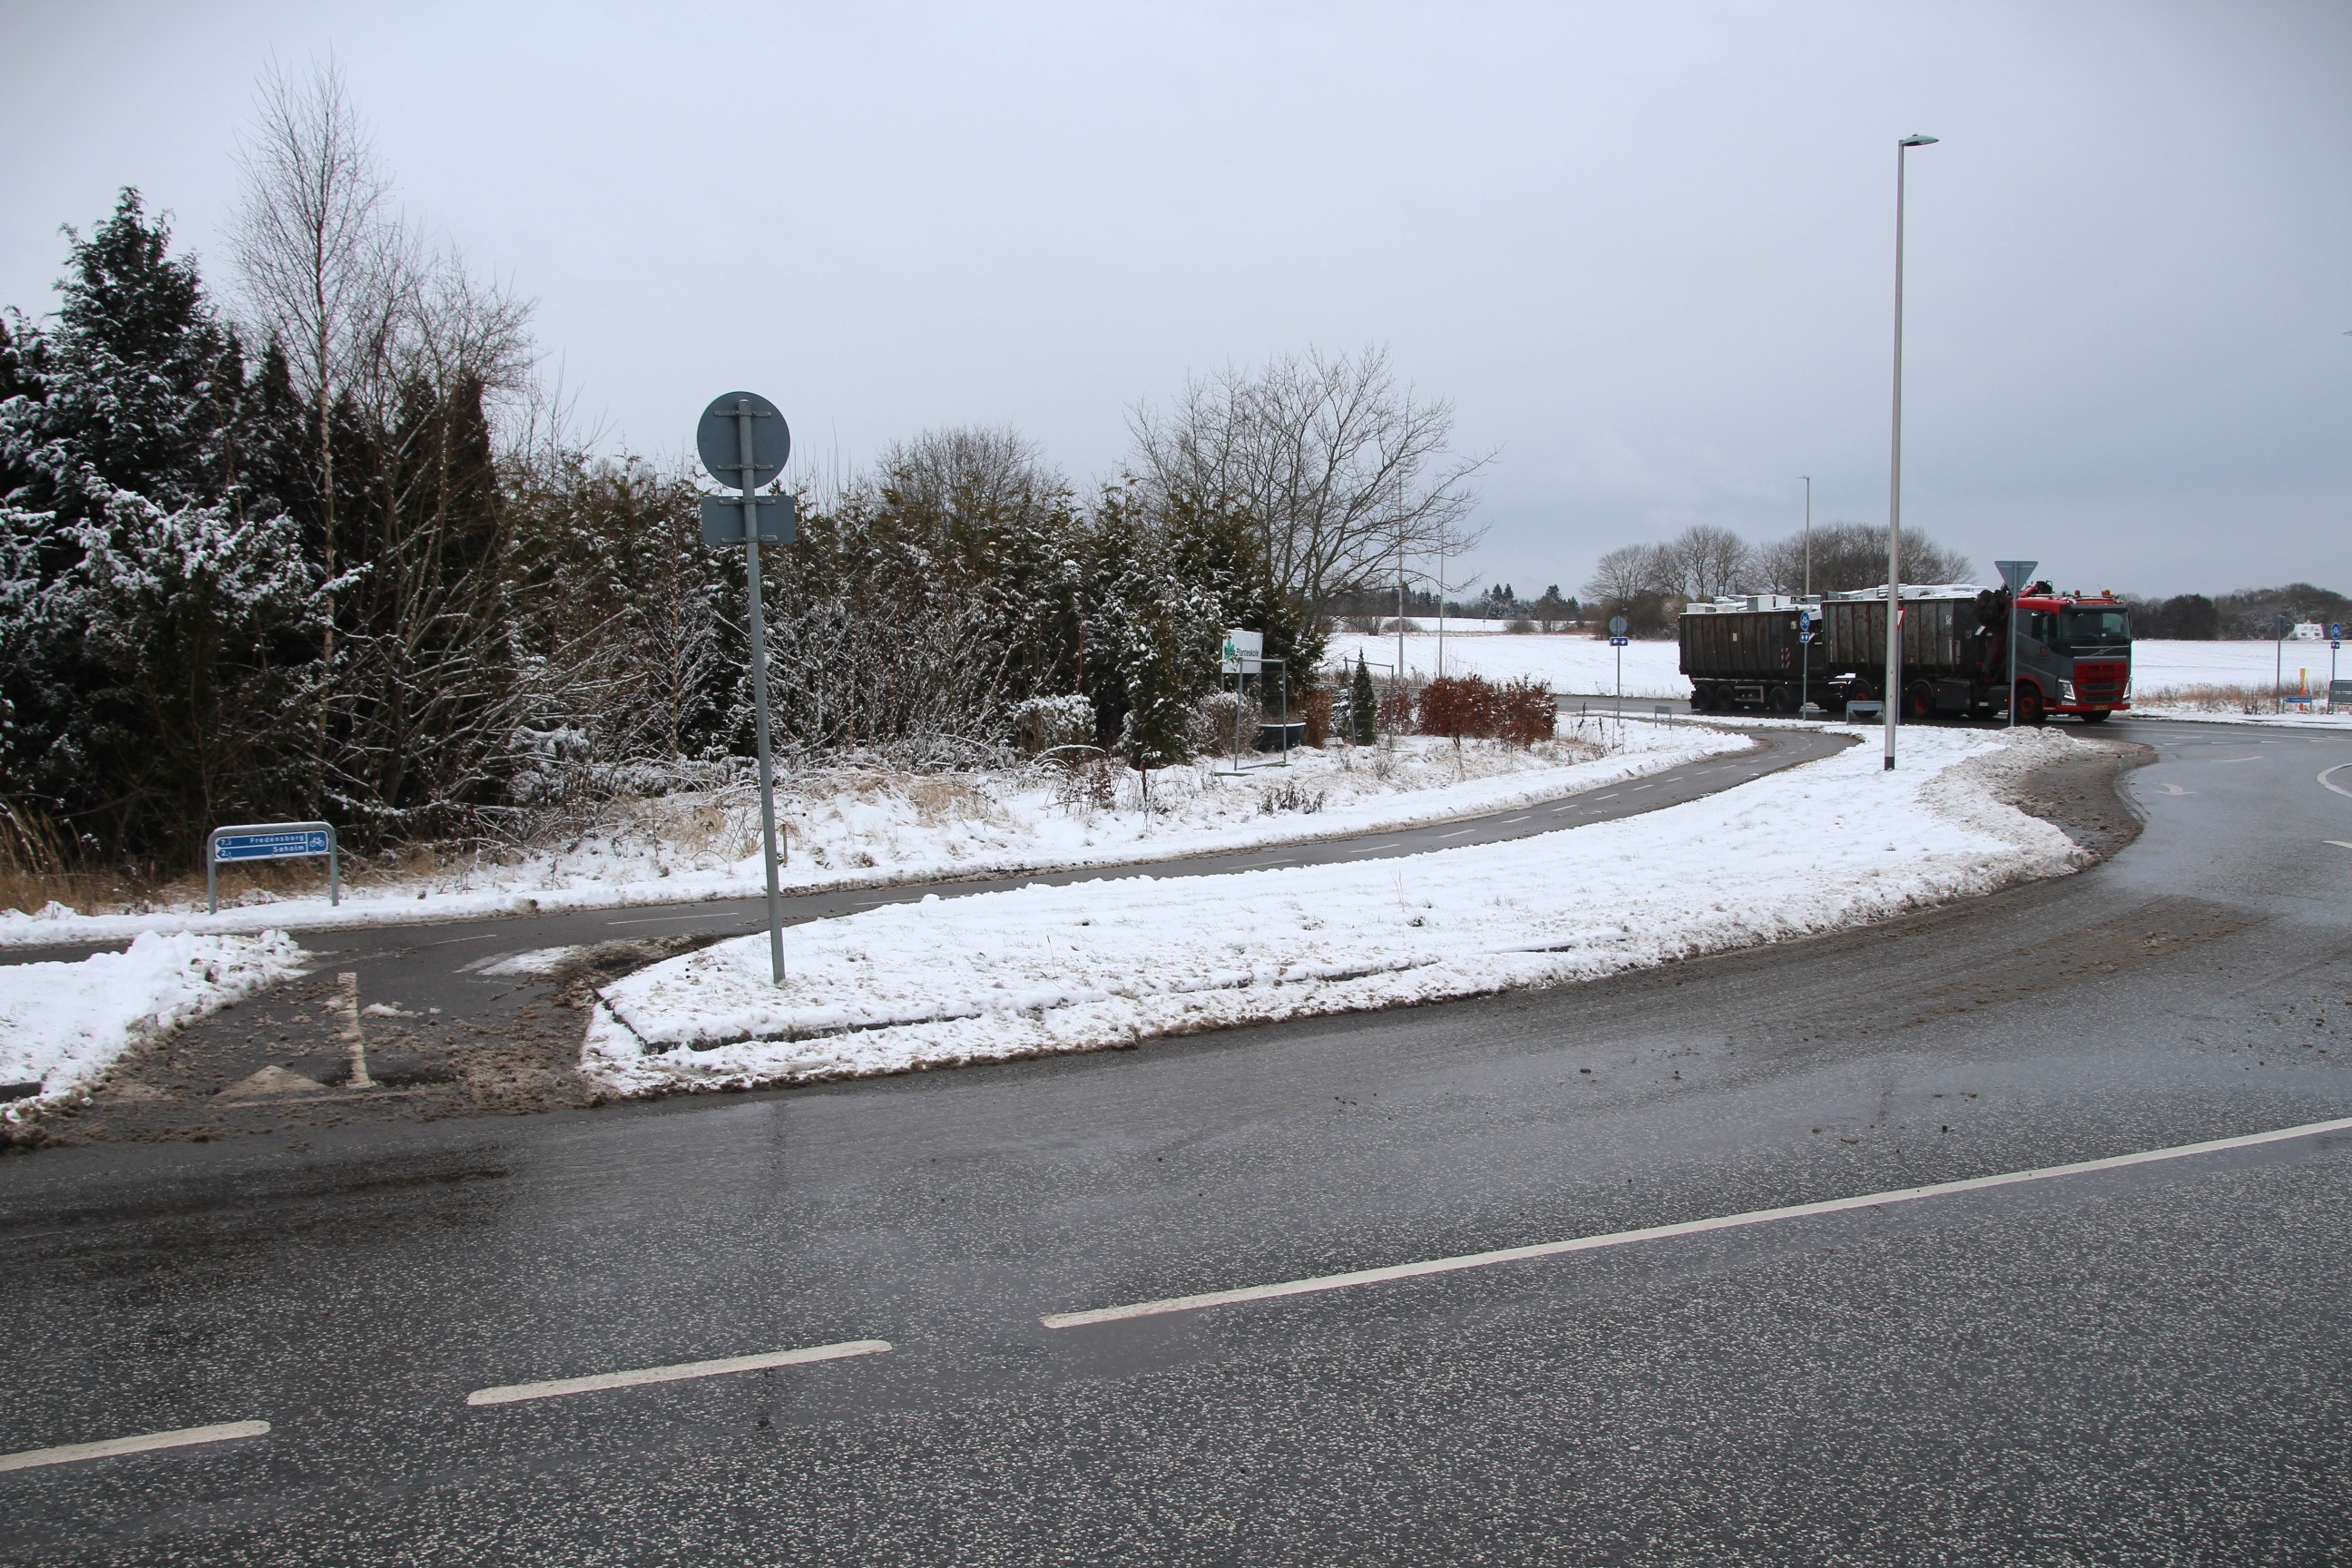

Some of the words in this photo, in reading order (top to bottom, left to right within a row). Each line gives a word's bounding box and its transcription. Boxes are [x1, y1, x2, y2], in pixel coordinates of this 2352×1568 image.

[1237, 648, 1259, 657] Planteskole
[250, 835, 304, 843] Fredensborg
[273, 845, 304, 853] Søholm
